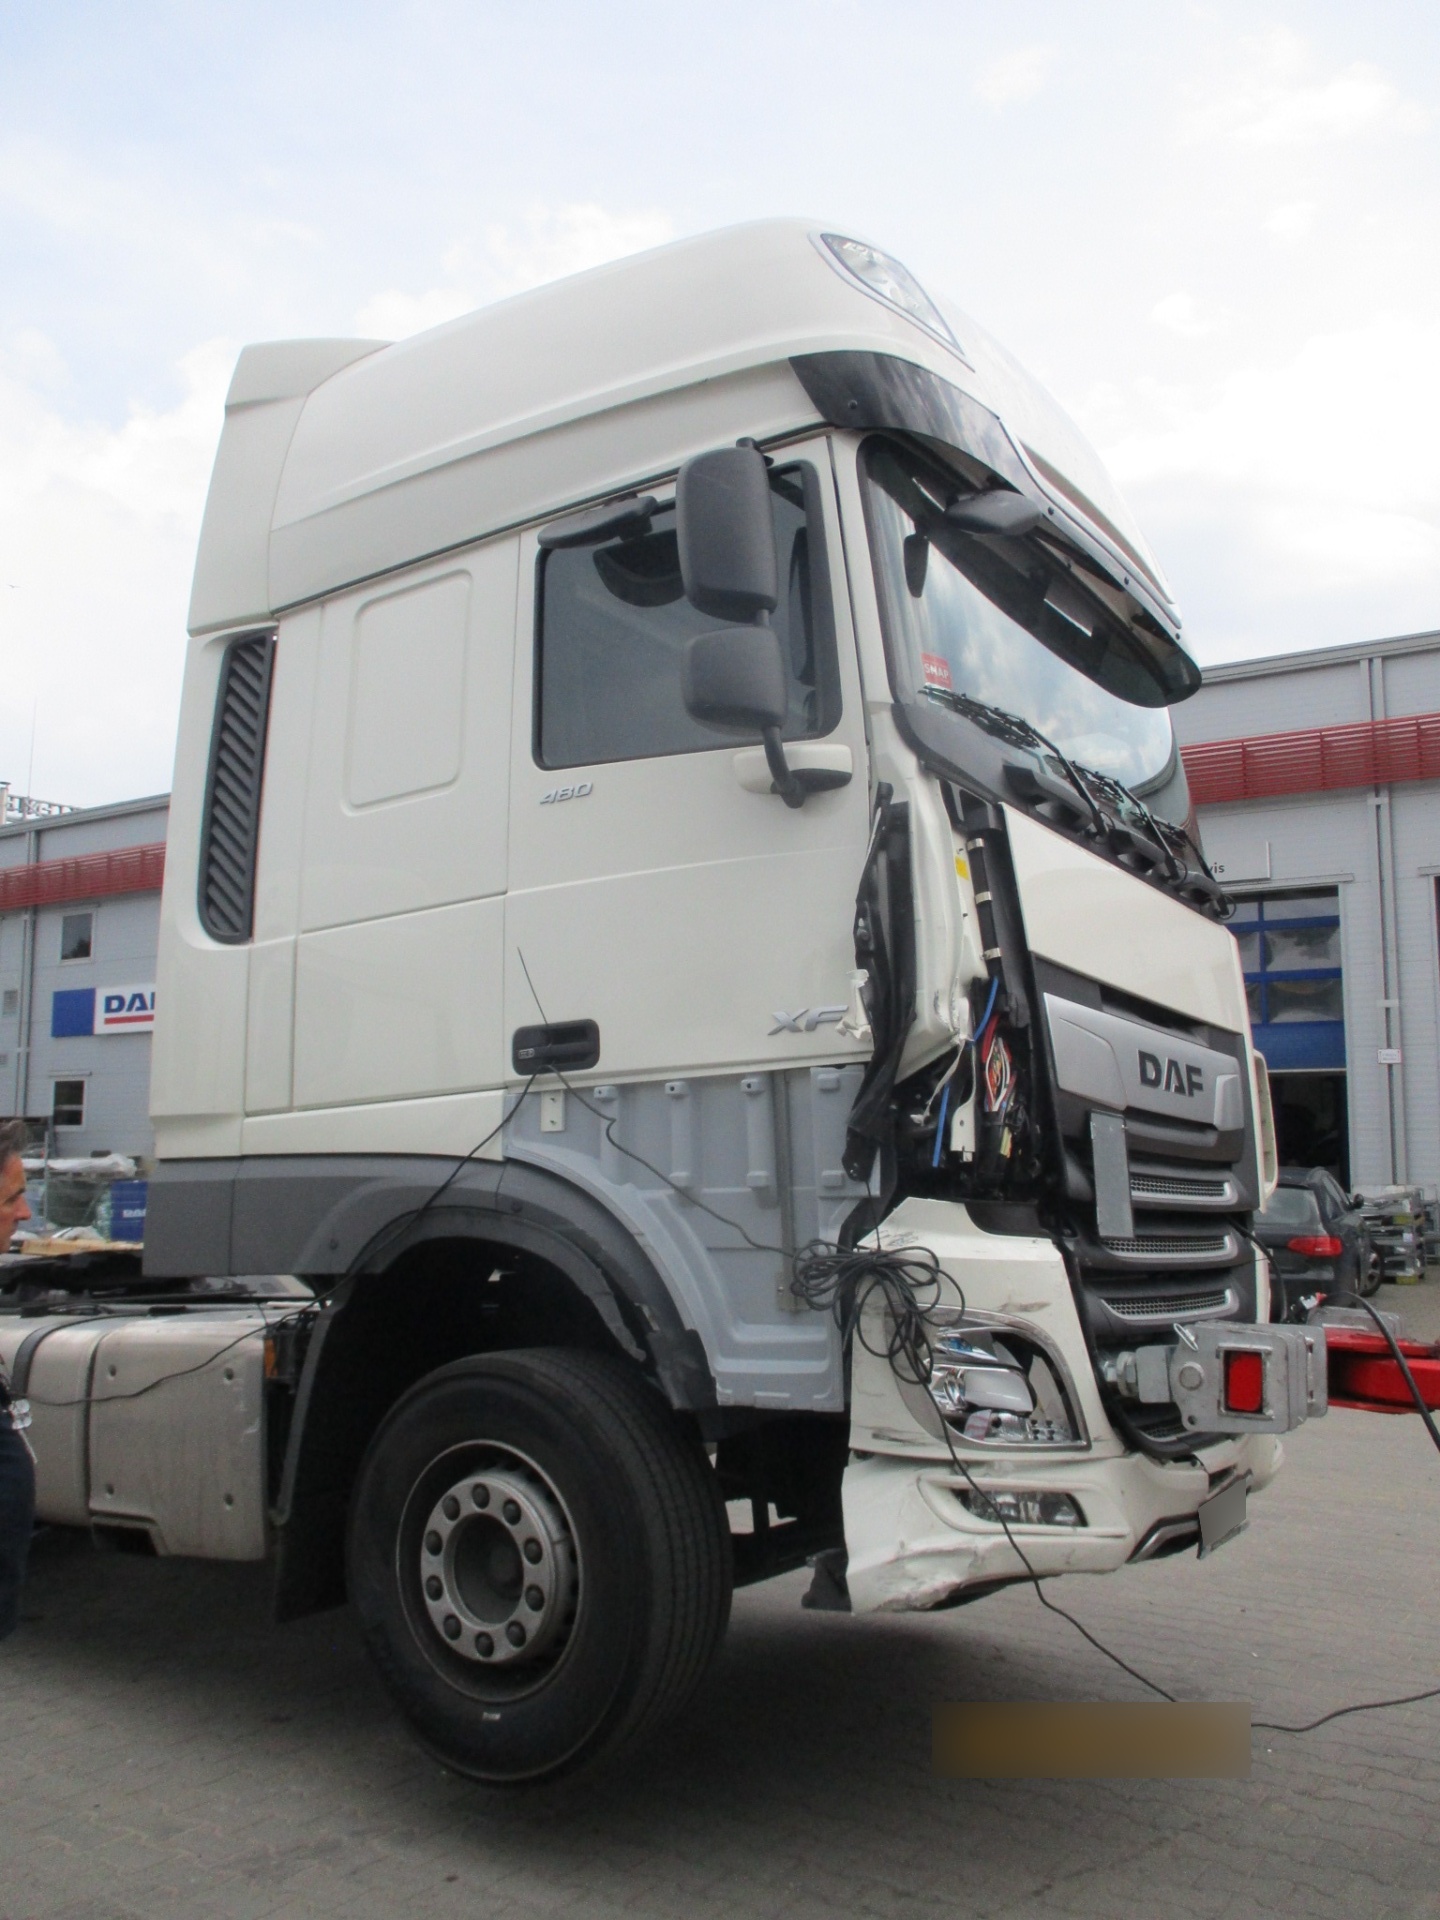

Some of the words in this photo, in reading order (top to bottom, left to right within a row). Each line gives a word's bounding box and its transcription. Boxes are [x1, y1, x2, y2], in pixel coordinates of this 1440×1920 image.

[539, 782, 593, 805] 480
[767, 1004, 849, 1036] XF
[1137, 1049, 1204, 1098] DAF
